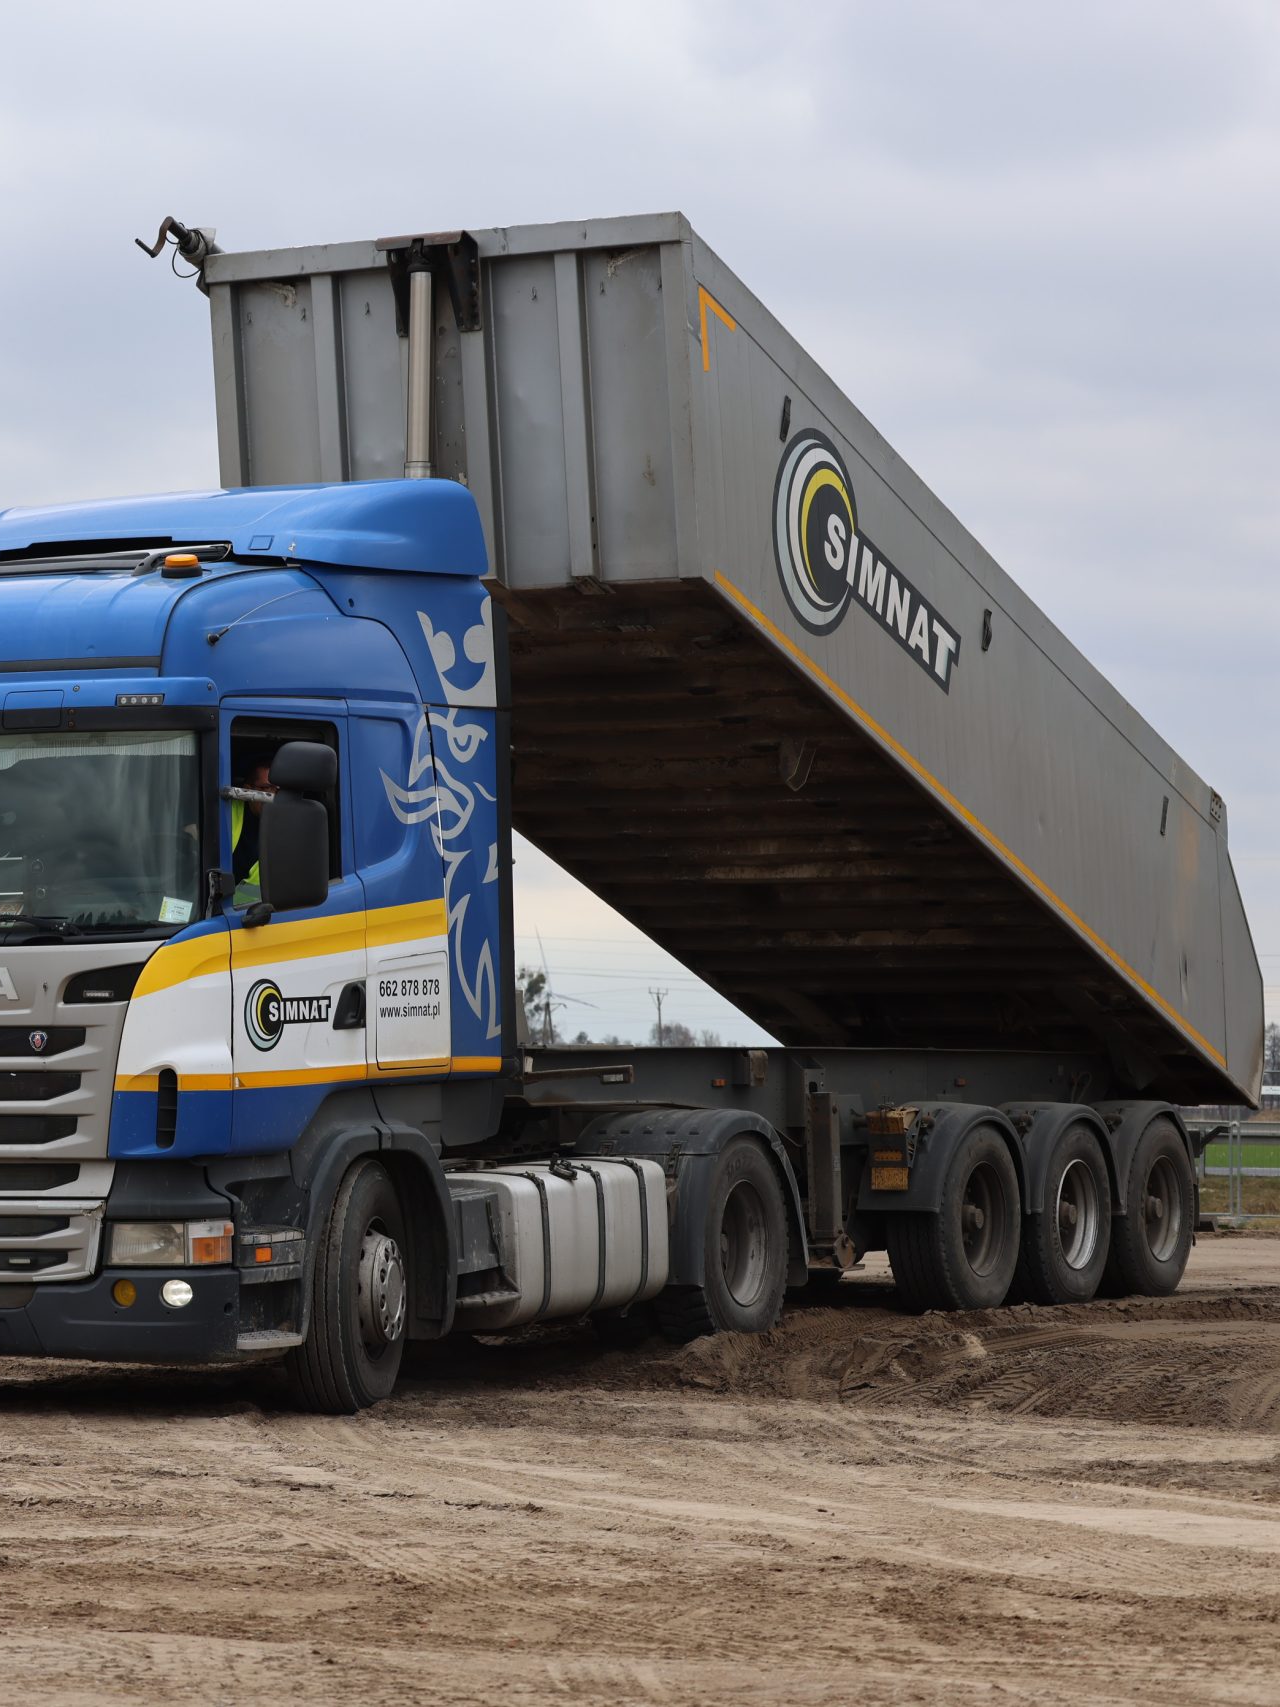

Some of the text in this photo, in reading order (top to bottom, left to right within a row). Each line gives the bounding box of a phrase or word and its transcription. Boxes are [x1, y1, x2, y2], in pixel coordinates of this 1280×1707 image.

[824, 514, 956, 682] SIMNAT
[379, 978, 440, 997] 662 878 878
[269, 1000, 330, 1022] SIMNAT
[380, 1001, 441, 1020] www.simnat.pl
